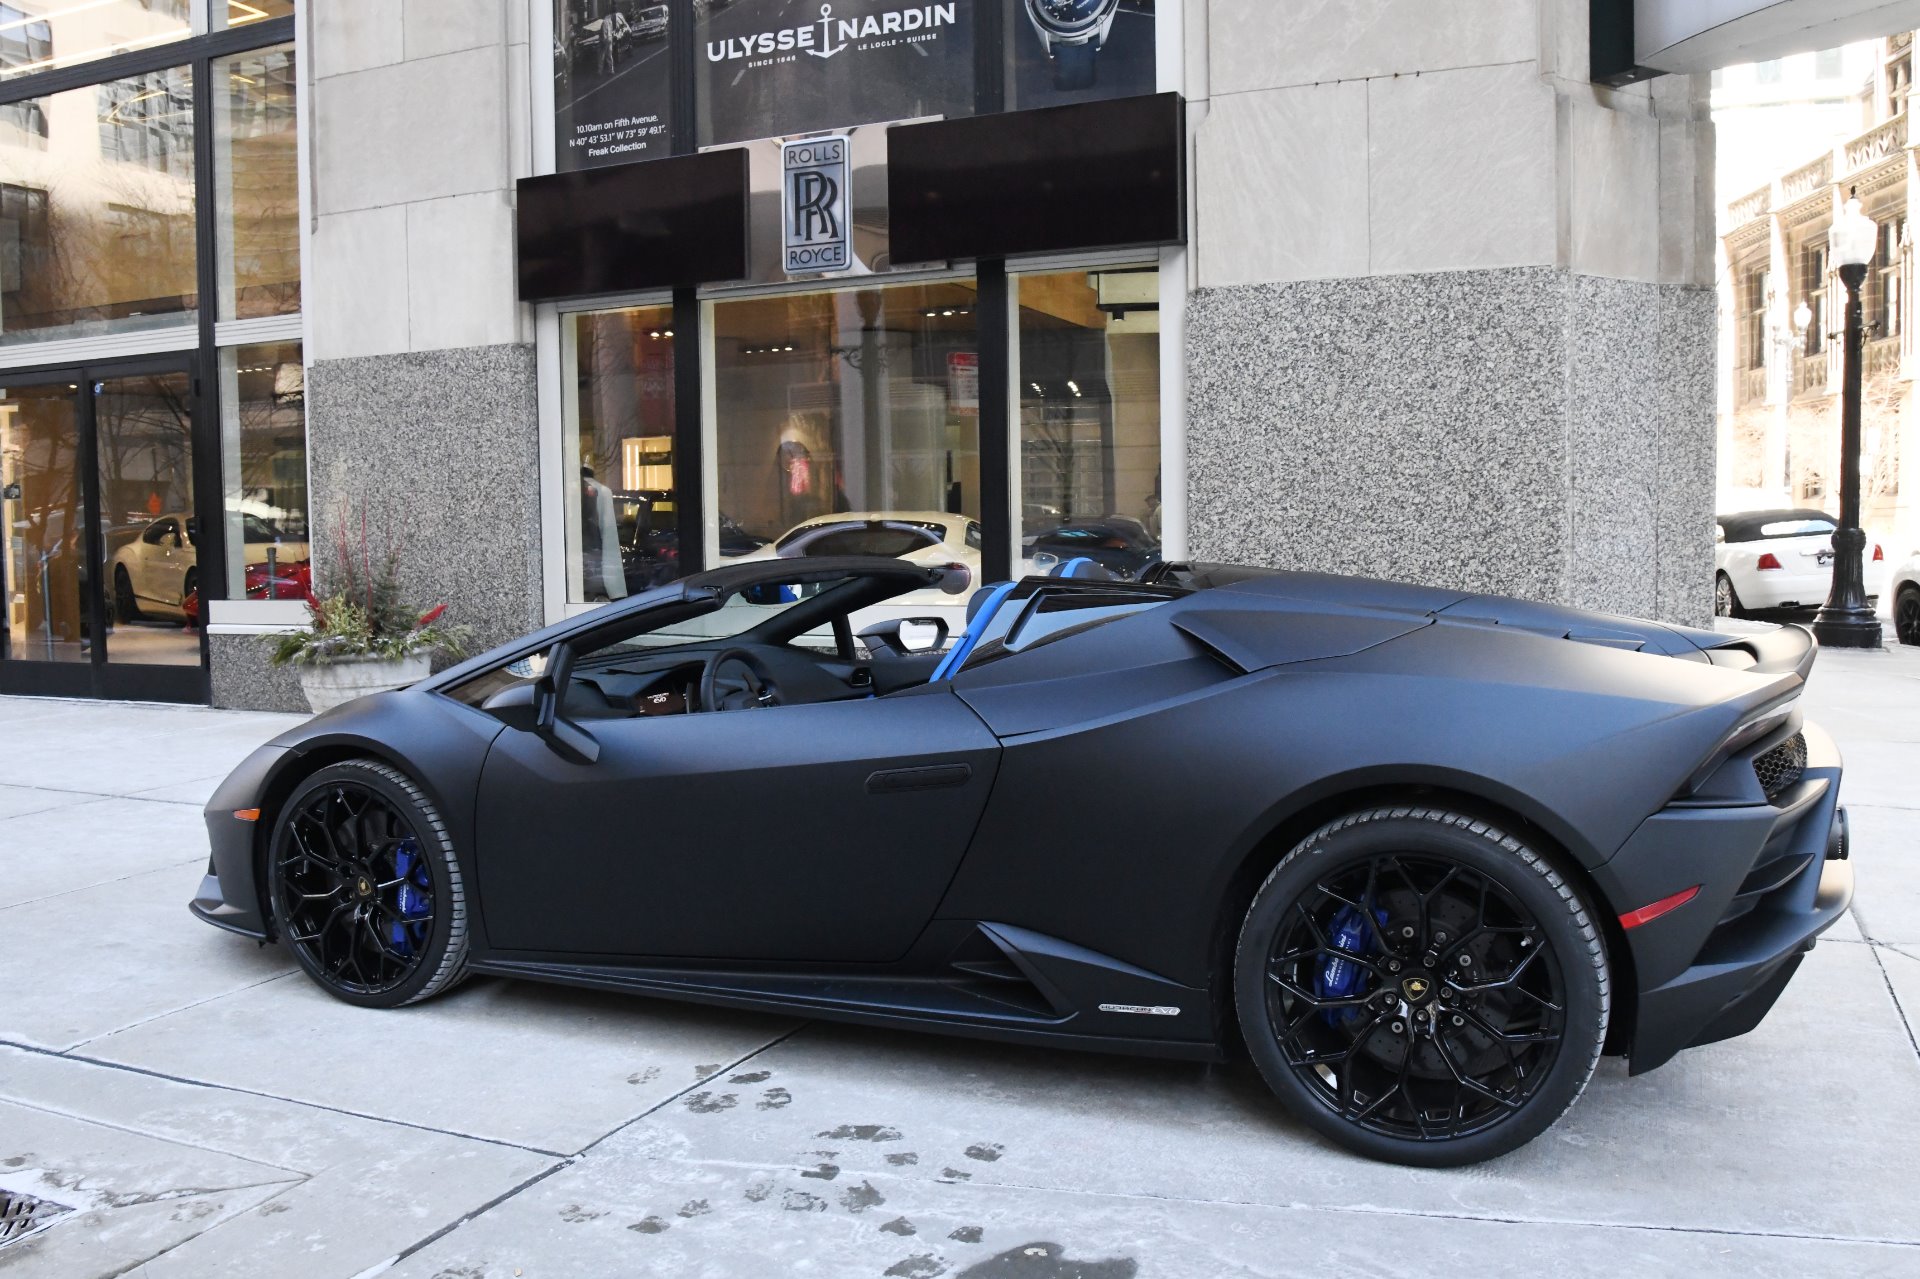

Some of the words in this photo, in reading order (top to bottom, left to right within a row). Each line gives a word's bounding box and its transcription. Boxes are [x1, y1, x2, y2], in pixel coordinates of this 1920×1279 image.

[707, 25, 814, 62] ULYSSE
[838, 2, 955, 41] NARDIN
[858, 43, 867, 51] LE
[870, 39, 896, 49] LOCLE
[907, 33, 937, 43] SUISSE
[748, 58, 773, 68] SINCE
[576, 123, 602, 134] 10.10am
[604, 121, 613, 130] on
[614, 118, 630, 128] Fifth
[631, 114, 659, 126] Avenue.
[569, 139, 575, 147] N
[576, 136, 588, 146] 40°
[616, 131, 625, 140] W
[588, 146, 609, 157] Freak
[609, 141, 647, 154] Collection
[788, 144, 840, 164] ROLLS
[793, 171, 839, 241] RR
[790, 246, 842, 265] ROYCE
